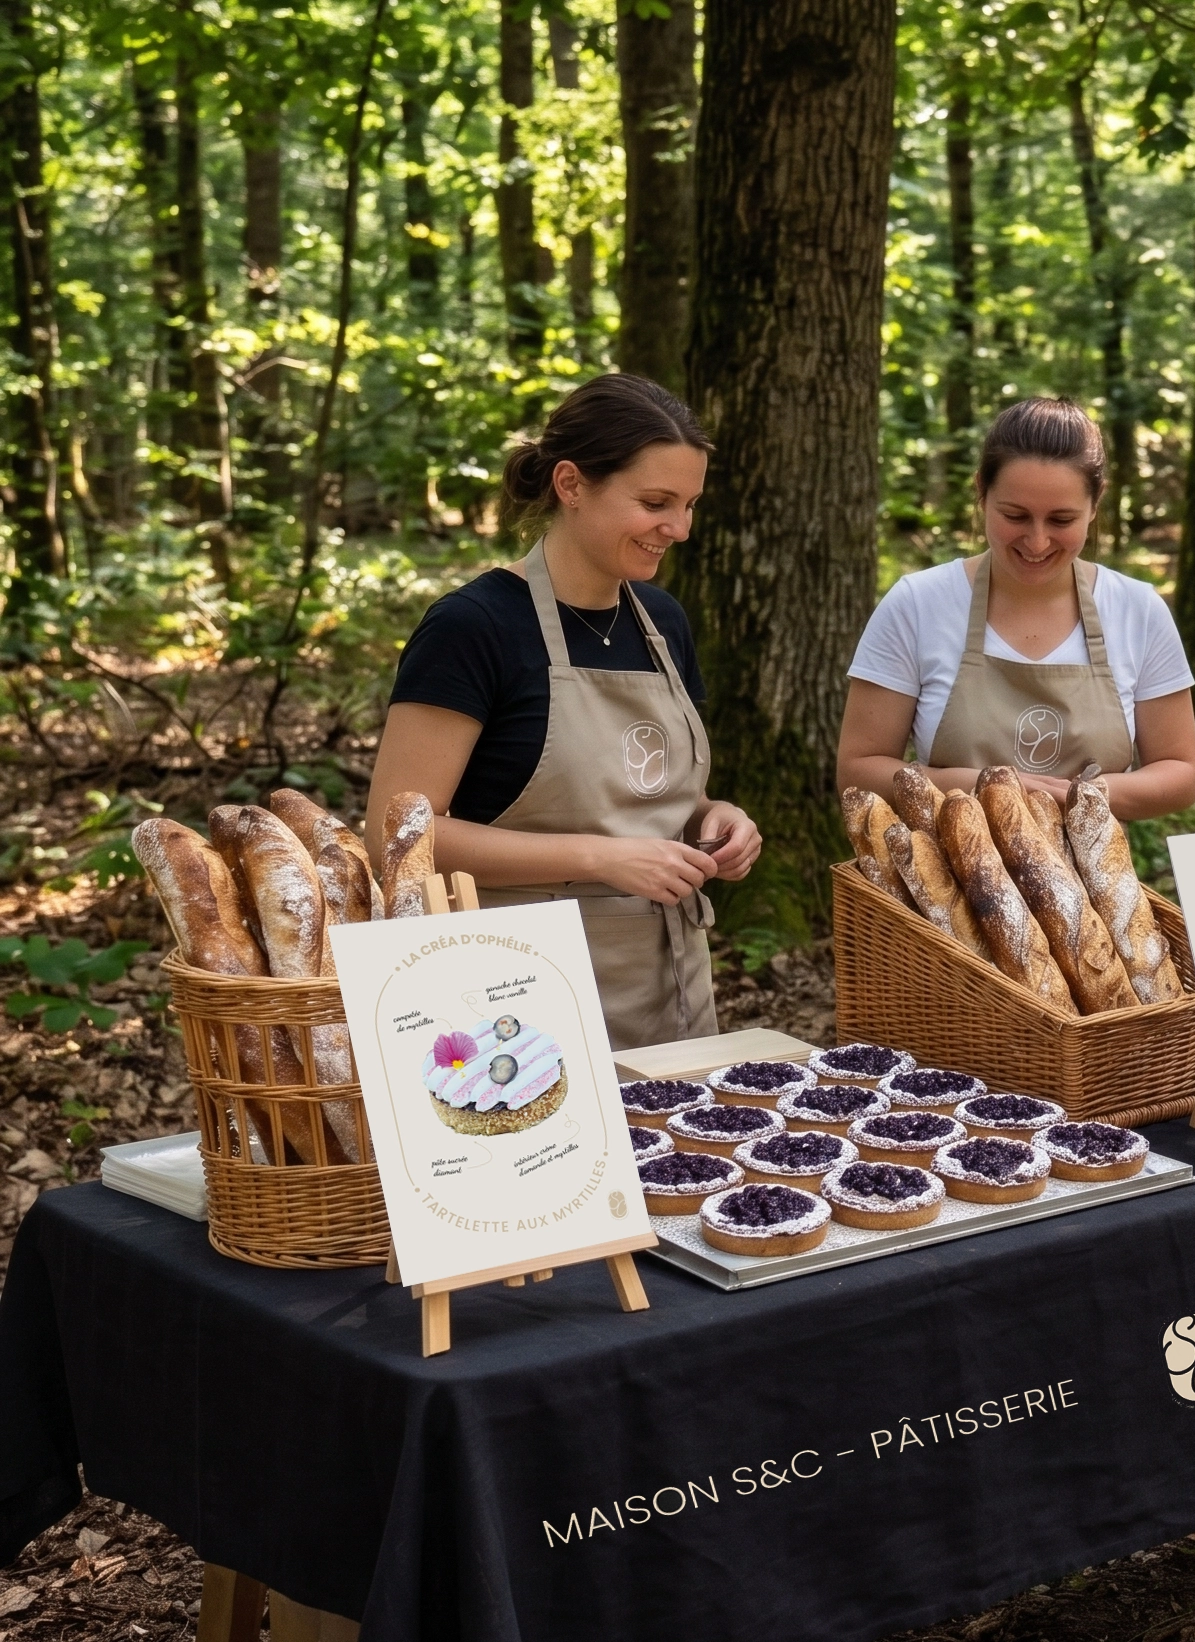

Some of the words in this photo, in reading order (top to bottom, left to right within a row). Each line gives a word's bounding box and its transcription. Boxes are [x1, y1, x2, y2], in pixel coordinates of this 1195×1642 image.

[402, 952, 421, 968] LA
[420, 935, 459, 956] CRÉA
[460, 933, 533, 955] D'OPHÉLIE
[512, 975, 537, 987] chocolat
[488, 994, 506, 1003] blanc
[396, 1024, 405, 1033] de
[421, 1191, 509, 1233] TARTELETTE
[516, 1214, 549, 1232] AUX
[552, 1159, 606, 1222] MYRTILLES
[542, 1475, 720, 1548] MAISON
[732, 1449, 823, 1496] S&C
[870, 1378, 1079, 1459] PÂTISSERIE
